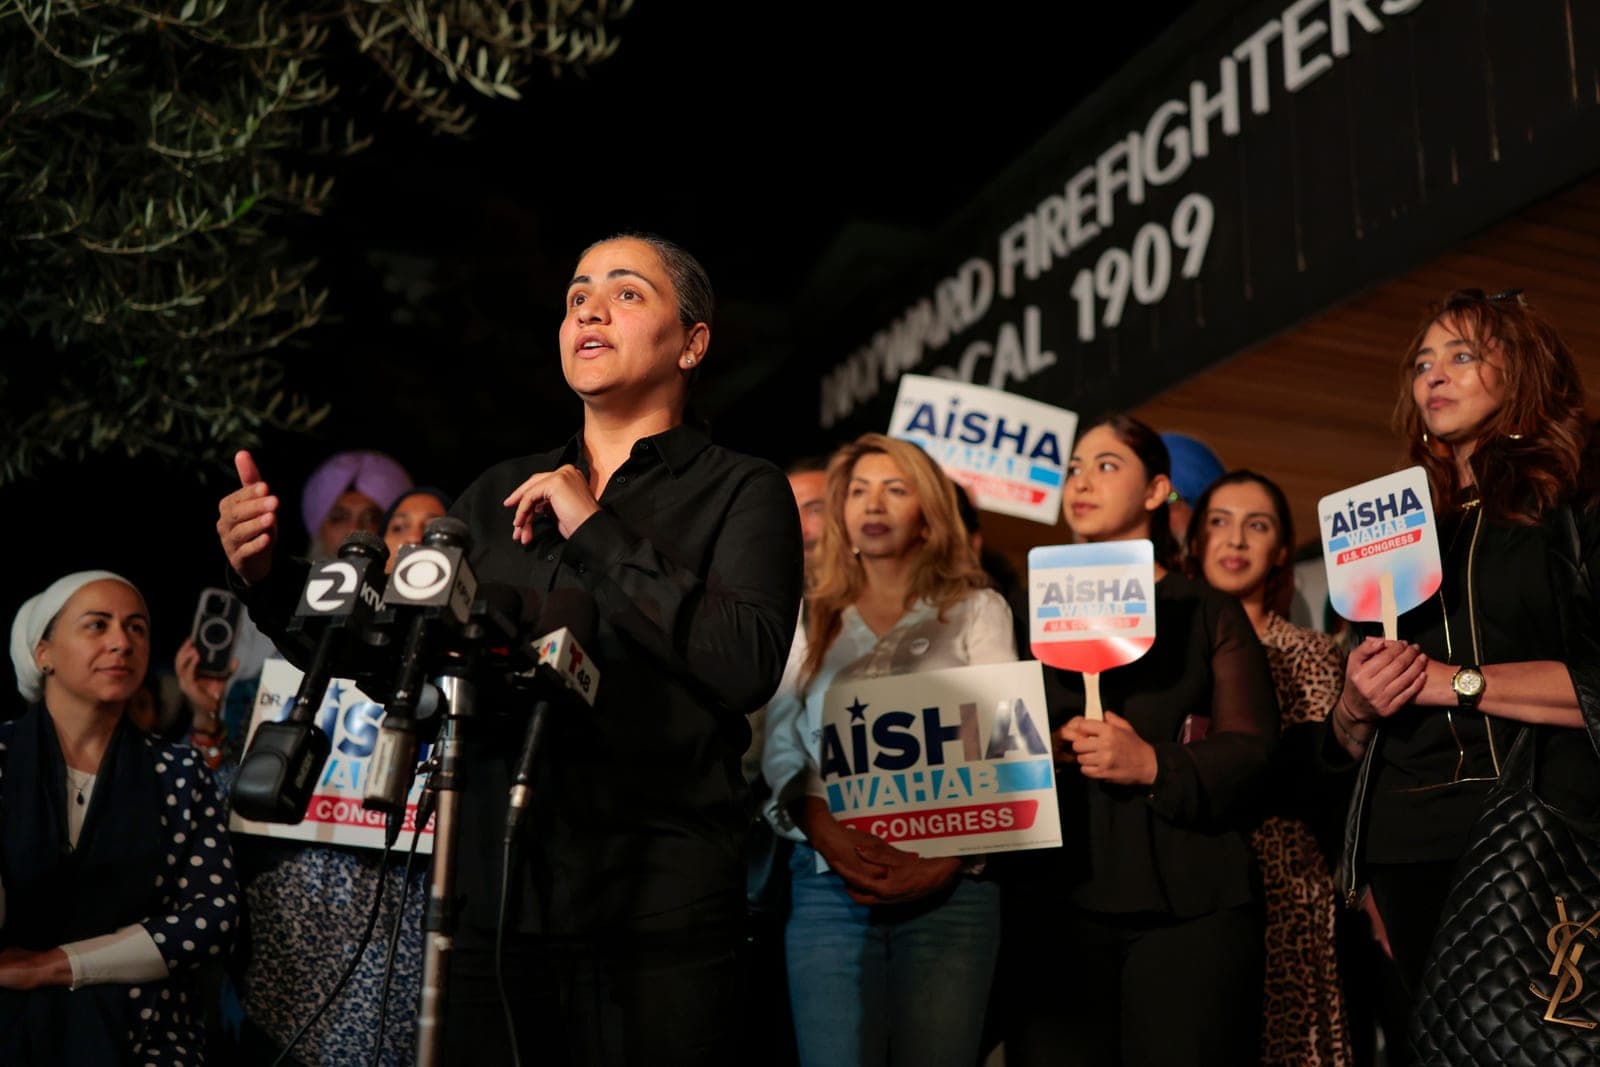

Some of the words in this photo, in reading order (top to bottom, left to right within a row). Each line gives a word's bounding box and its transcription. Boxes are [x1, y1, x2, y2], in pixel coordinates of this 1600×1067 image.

[1000, 0, 1420, 298] FIREFIGHTER
[932, 305, 1057, 390] CAL
[1069, 193, 1214, 341] 1909
[1361, 534, 1415, 556] CONGRESS
[360, 581, 386, 612] KTV
[838, 764, 1000, 811] WAHAB
[870, 807, 1015, 840] CONGRESS
